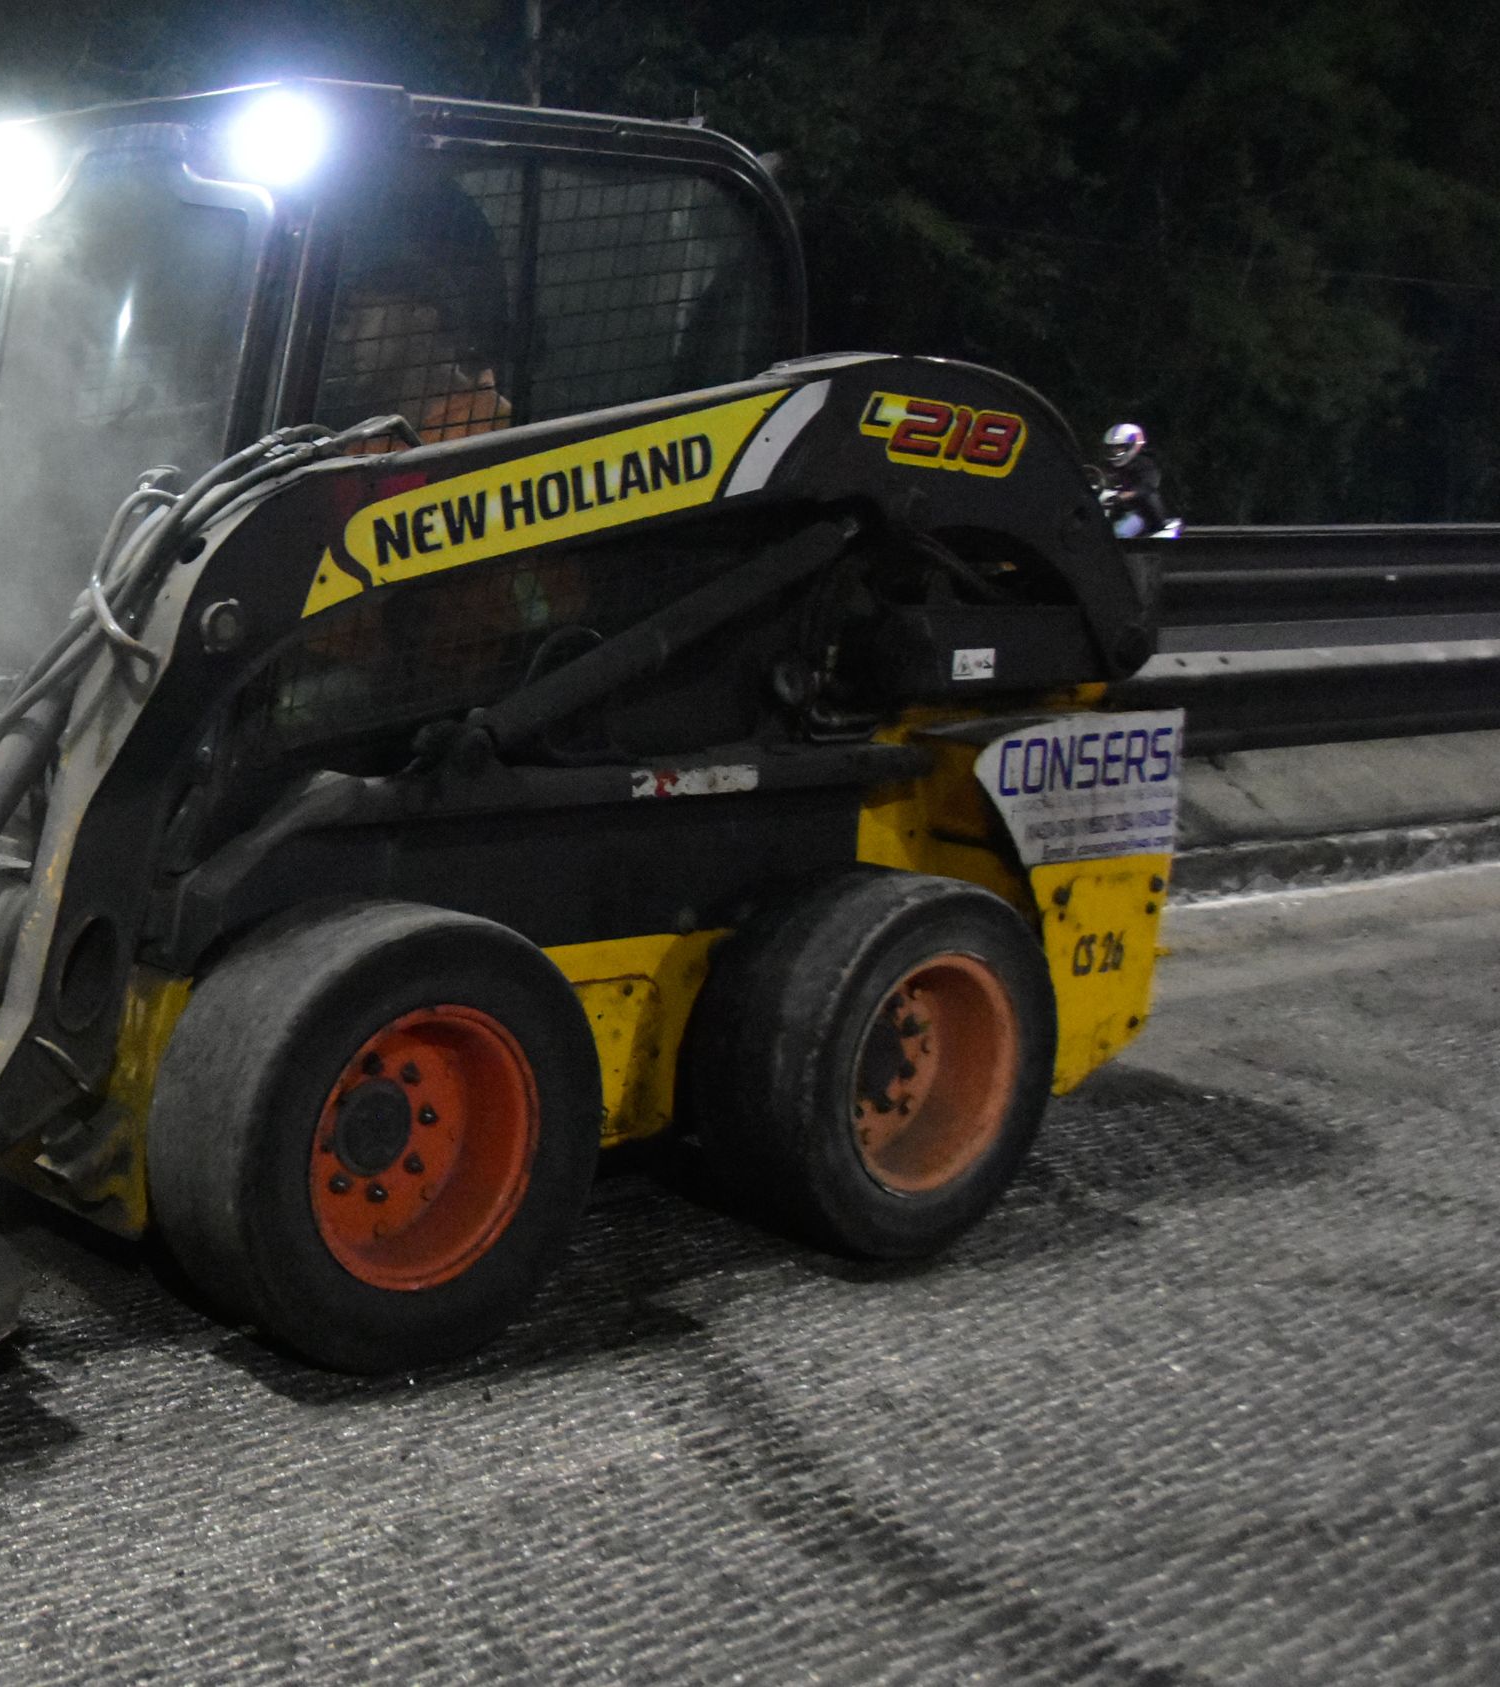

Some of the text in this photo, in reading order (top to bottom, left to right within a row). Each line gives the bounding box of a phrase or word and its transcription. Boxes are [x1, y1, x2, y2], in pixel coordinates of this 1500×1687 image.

[372, 433, 713, 567] NEW HOLLAND
[1000, 727, 1173, 797] CONSERS
